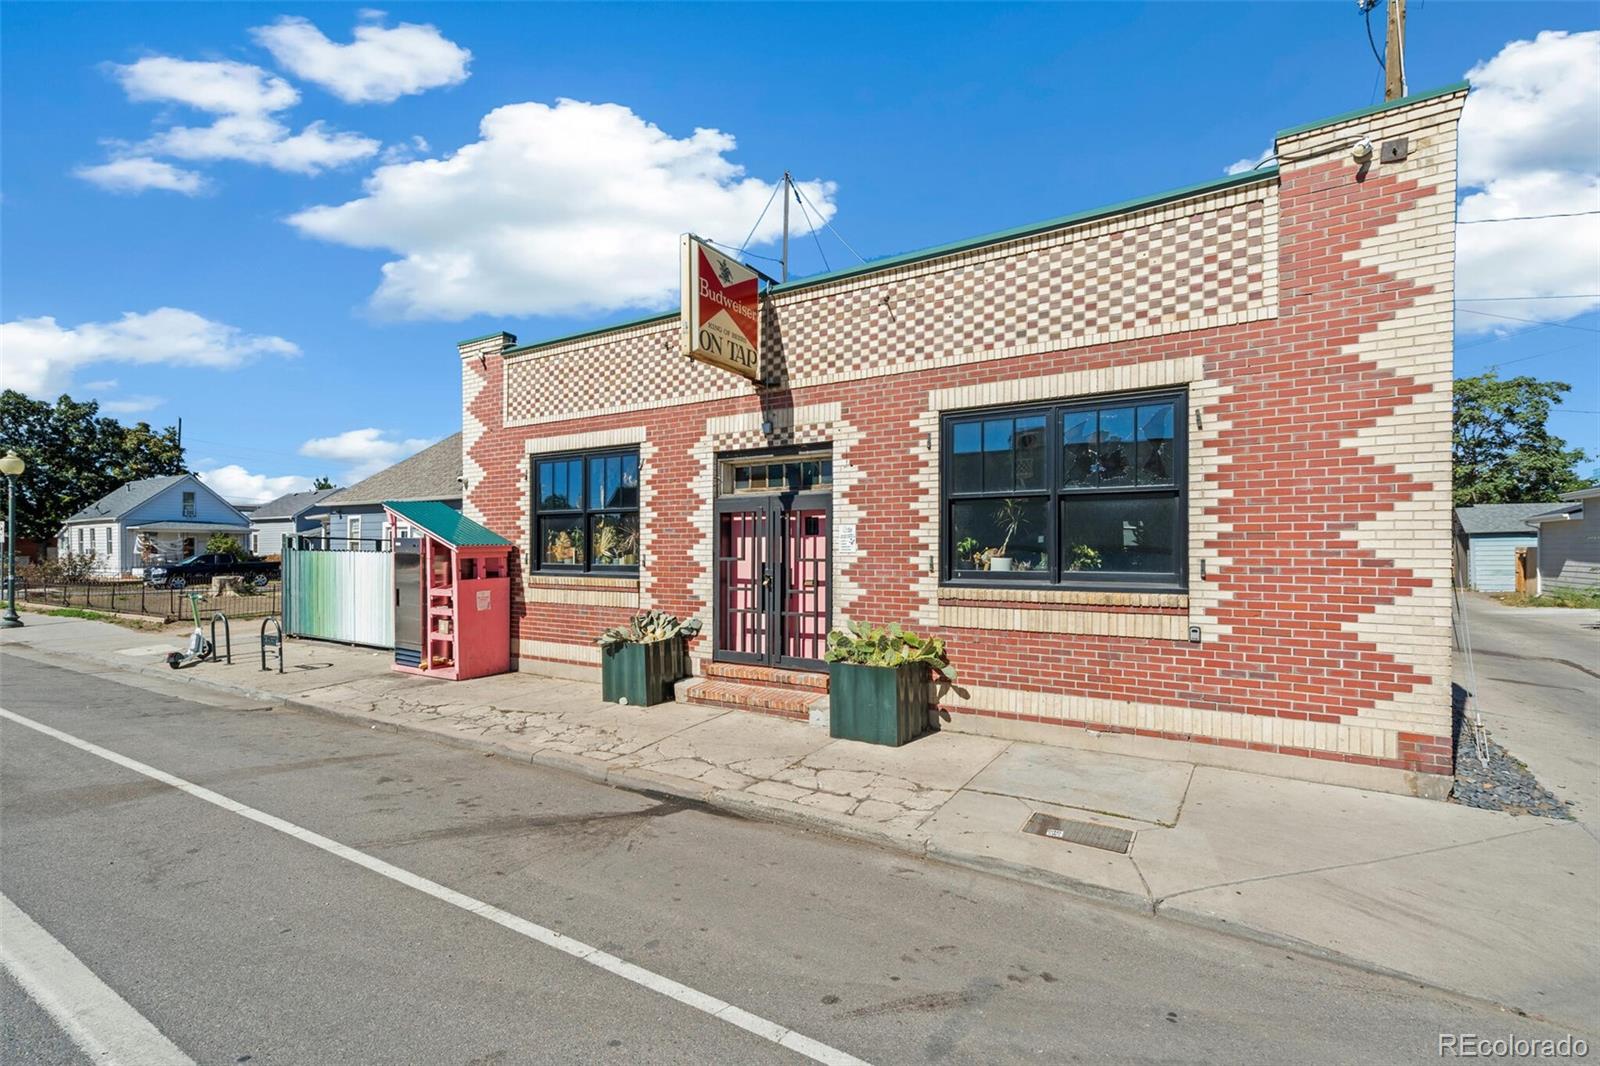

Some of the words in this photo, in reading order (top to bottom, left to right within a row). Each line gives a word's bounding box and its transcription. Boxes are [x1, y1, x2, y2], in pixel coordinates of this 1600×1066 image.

[699, 277, 757, 321] Budweiser
[699, 329, 723, 356] ON
[727, 340, 757, 368] TAP
